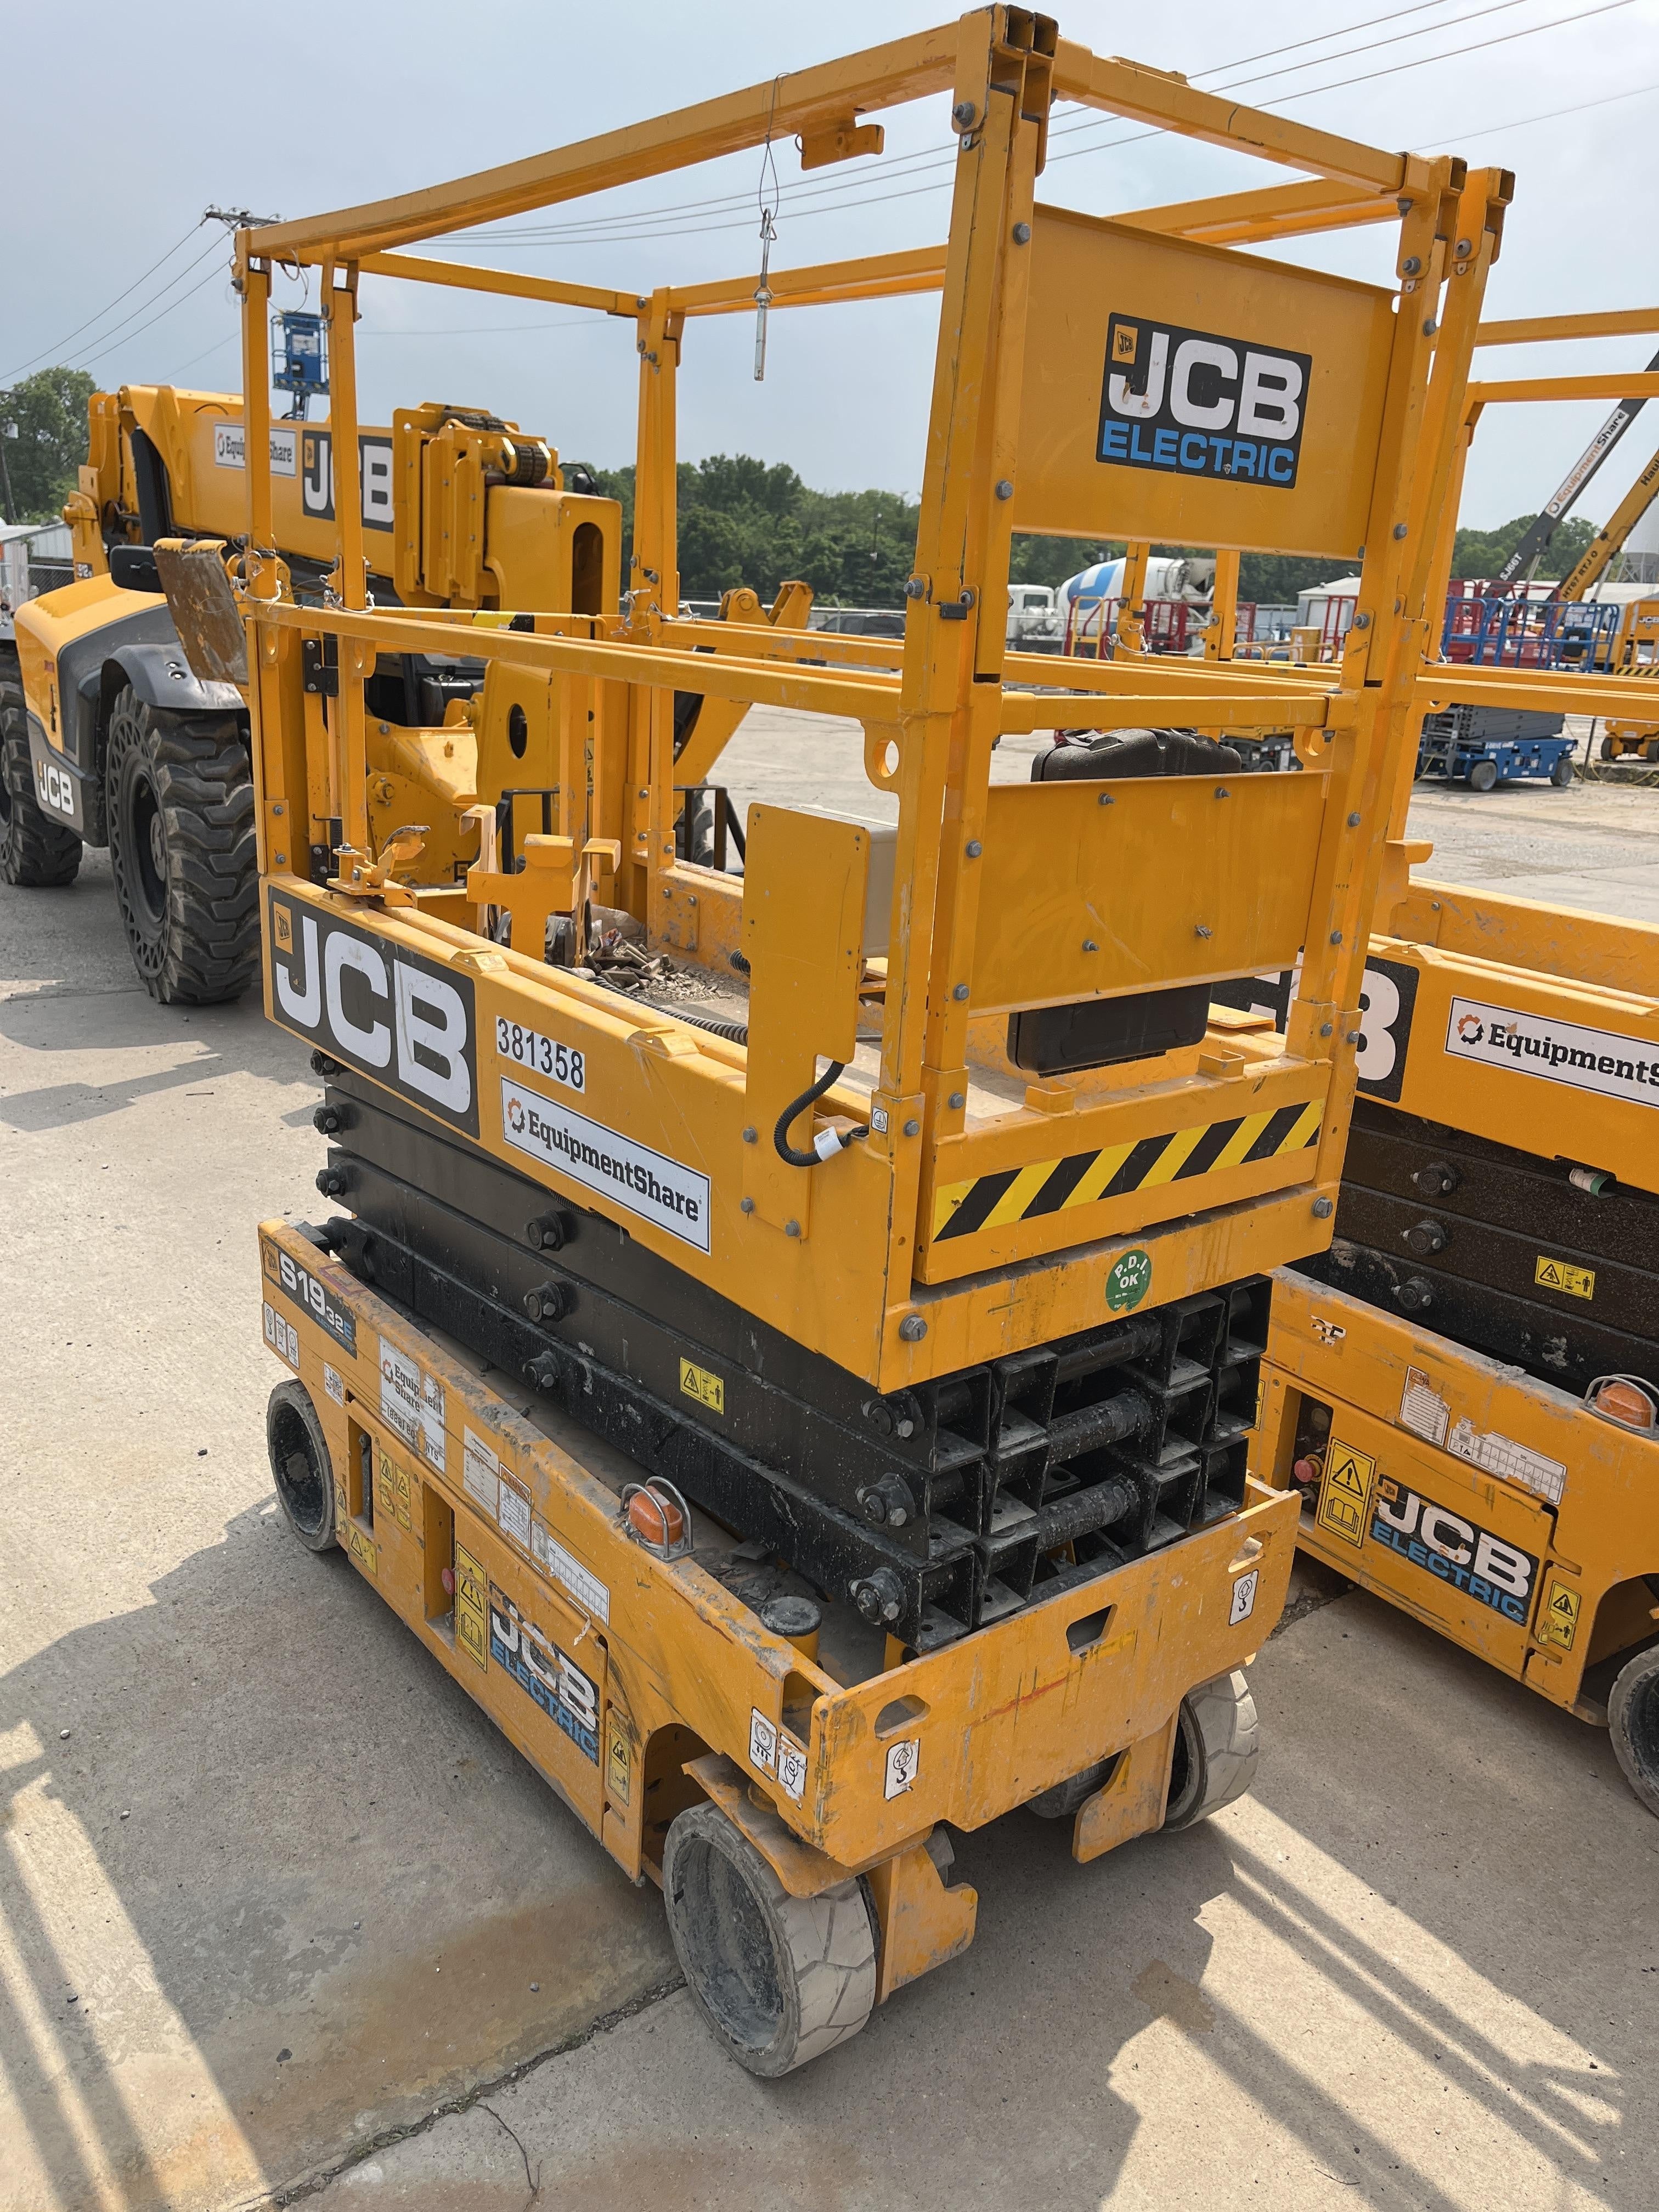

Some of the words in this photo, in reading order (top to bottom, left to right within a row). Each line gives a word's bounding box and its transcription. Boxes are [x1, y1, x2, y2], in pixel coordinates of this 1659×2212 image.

[1109, 331, 1302, 441] JCB
[303, 439, 393, 523] JB
[1102, 420, 1294, 482] ELECTRIC
[1558, 413, 1625, 503] EquipmentShare
[40, 763, 74, 816] JCB
[276, 915, 471, 1113] JCB
[498, 1018, 584, 1088] 381358
[528, 1109, 699, 1222] EquipmentShare
[1114, 1255, 1148, 1278] P.D.I.
[1120, 1273, 1138, 1289] OK
[1373, 1520, 1524, 1622] ELECTRIC
[1378, 1493, 1531, 1597] JCB
[492, 1604, 596, 1732] JCB
[492, 1636, 597, 1759] ELECTRIC
